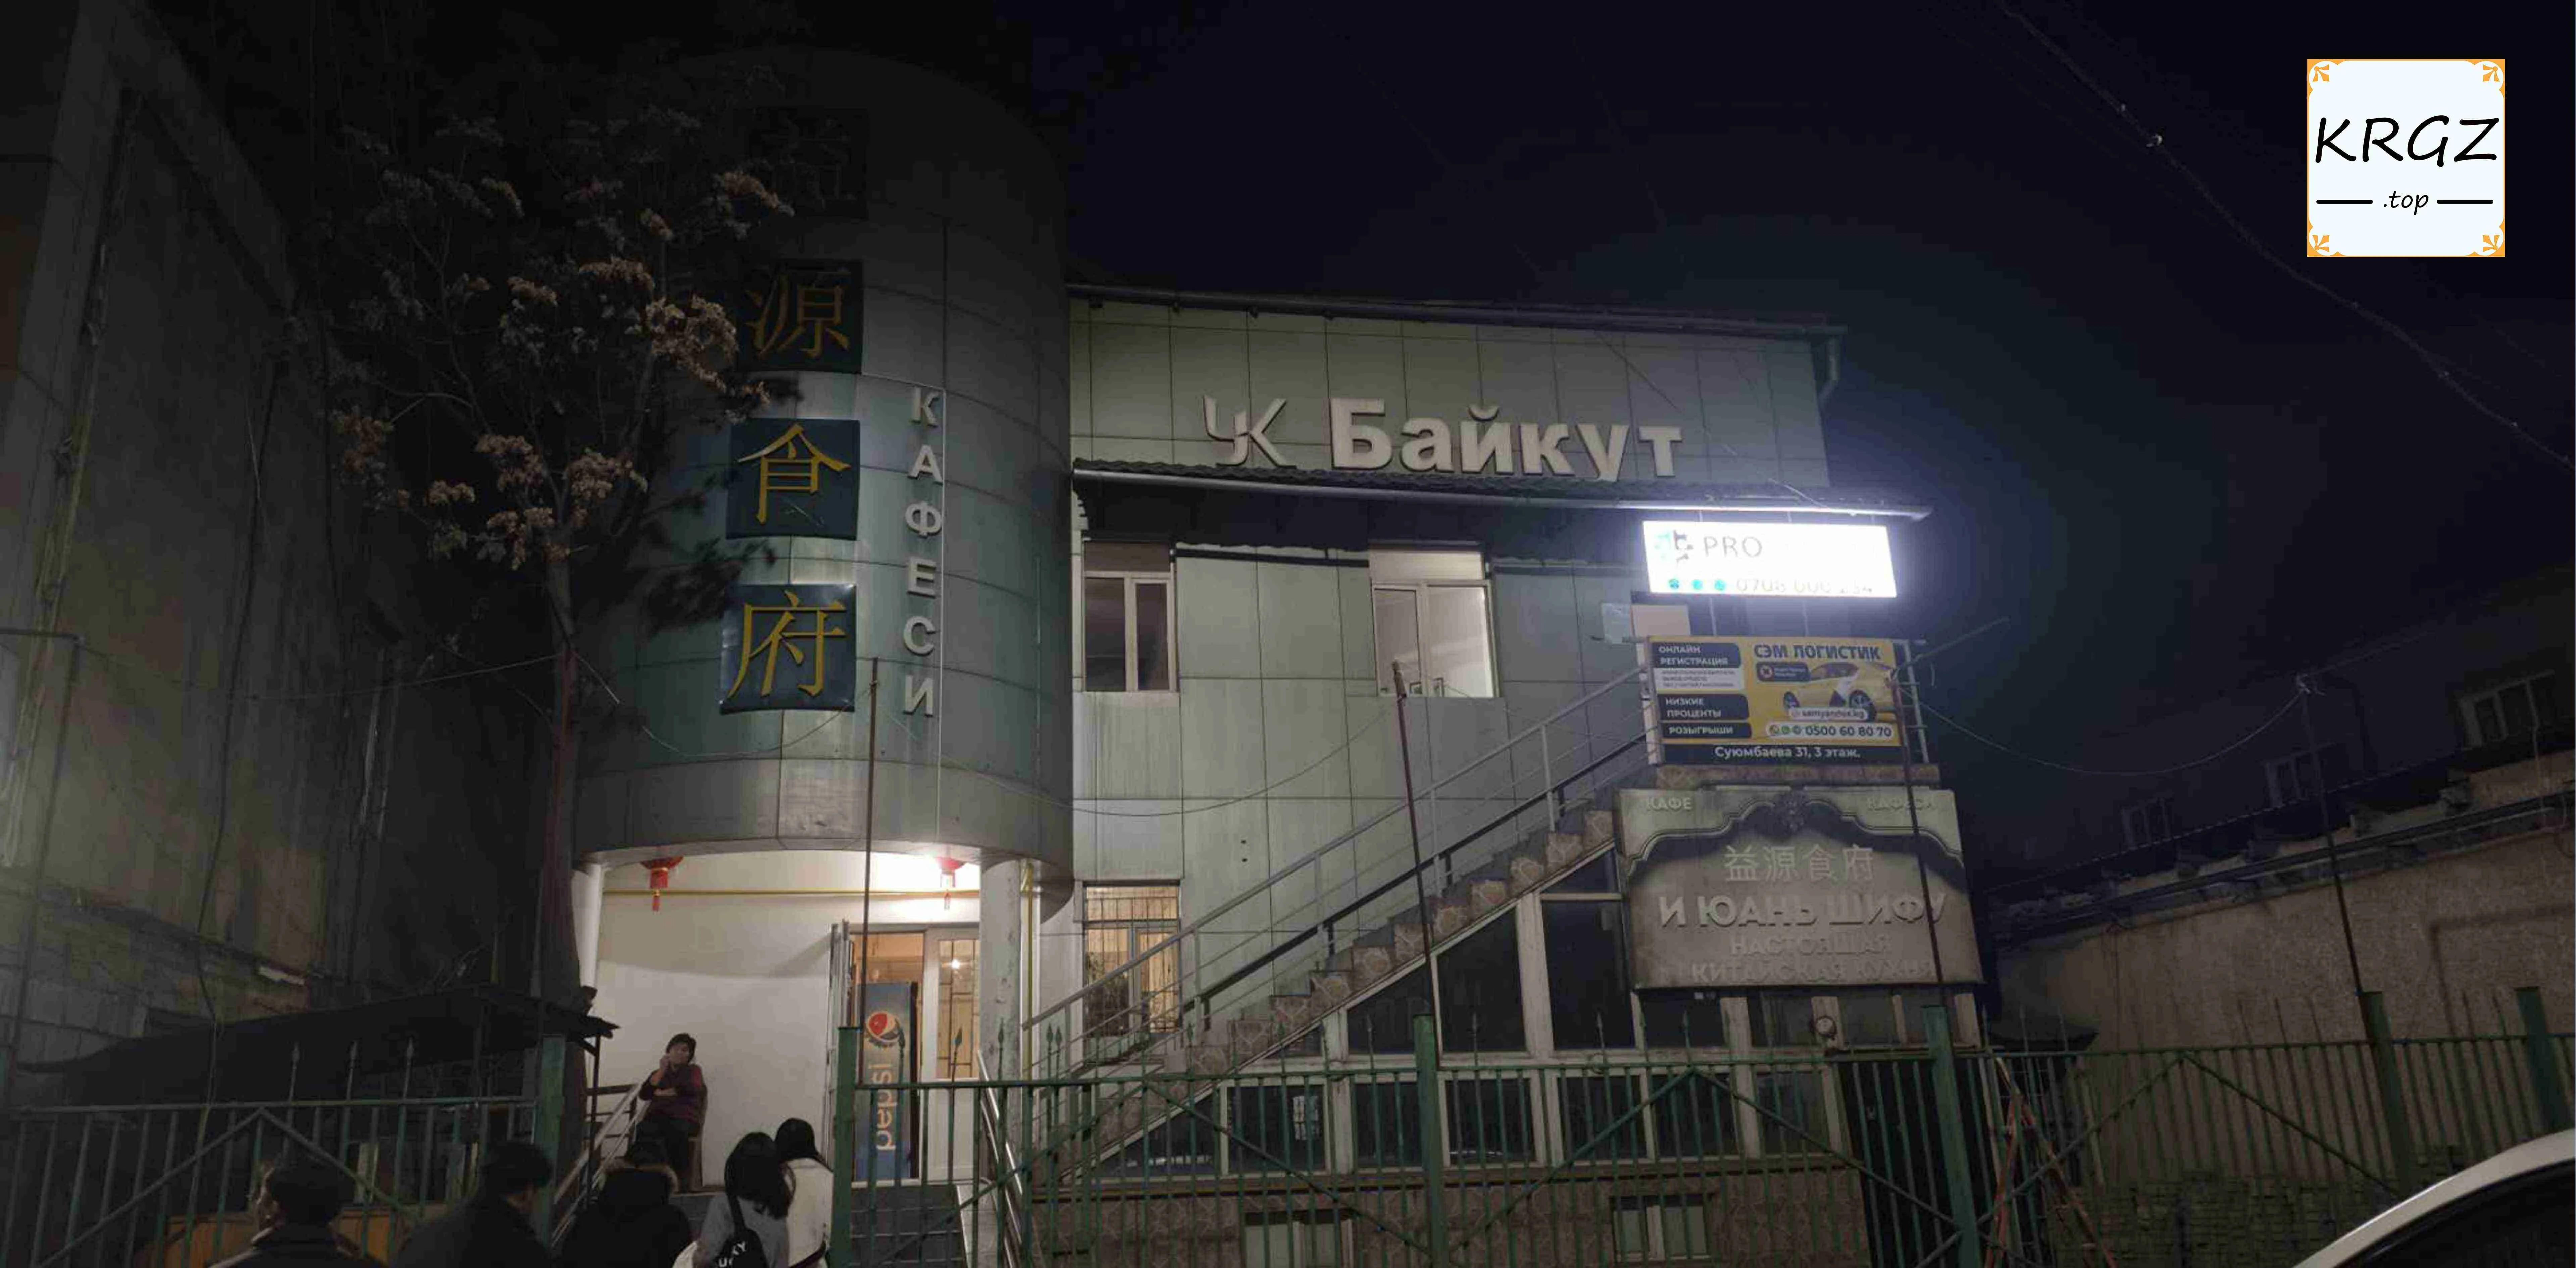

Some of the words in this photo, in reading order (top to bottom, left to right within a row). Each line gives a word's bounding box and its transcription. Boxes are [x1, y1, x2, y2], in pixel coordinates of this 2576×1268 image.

[1329, 397, 1682, 482] Байкут
[903, 387, 942, 717] КАФЕСИ
[1703, 535, 1763, 558] PRO
[1659, 645, 1701, 653] ОНЛАЙН
[1754, 644, 1788, 658] СЭМ
[1793, 645, 1881, 660] ЛОГИСТИК
[1661, 657, 1728, 666] РЕГИСТРАЦИЯ
[1667, 709, 1721, 718] ПРОЦЕНТЫ
[1669, 726, 1734, 734] РОЗЫГРЫШИ
[1805, 725, 1836, 735] 0500
[1839, 726, 1855, 735] 60
[1858, 726, 1873, 736] 80
[1877, 727, 1892, 737] 70
[1714, 746, 1792, 759] Суюмбаева
[1795, 747, 1811, 758] 31,
[1815, 747, 1822, 757] 3
[1824, 748, 1861, 758] этаж.
[1647, 796, 1693, 810] КАФЕ
[1724, 843, 1874, 883] 益源食府
[1658, 895, 1686, 927] И
[1696, 894, 1819, 927] ЮАНЬ
[868, 1064, 897, 1151] pepsi
